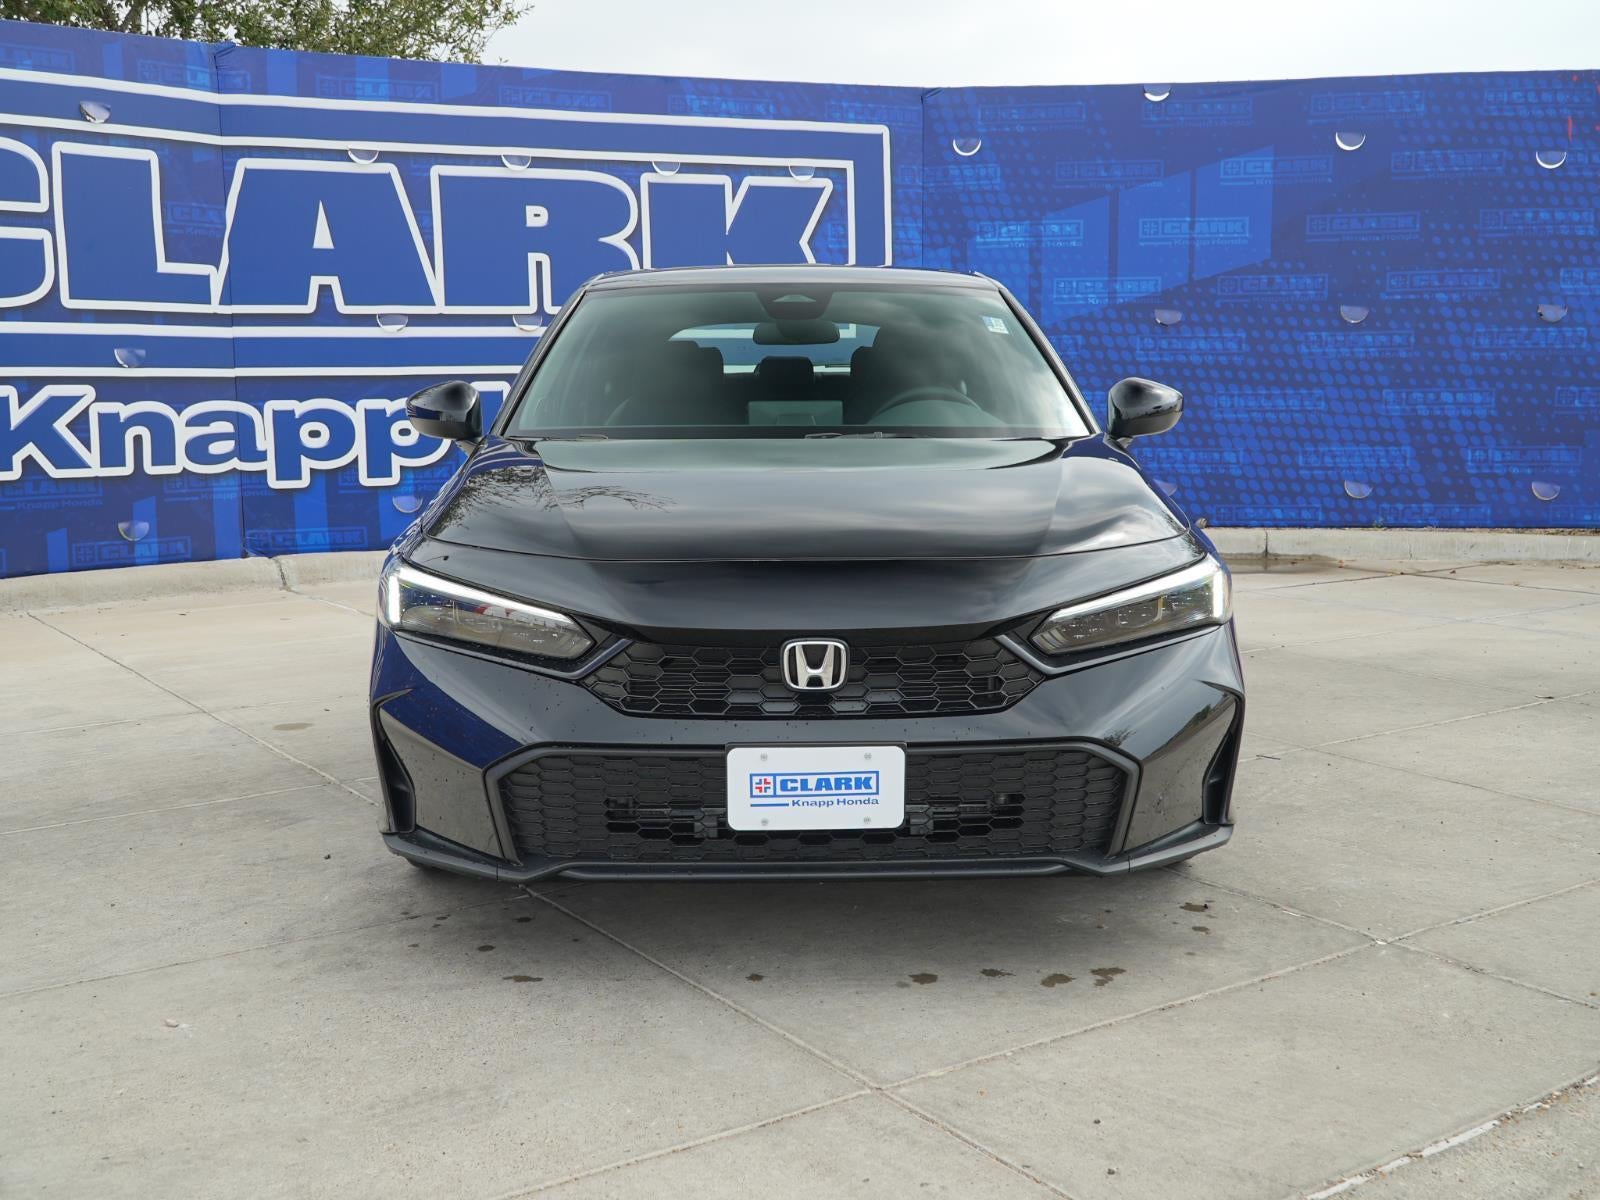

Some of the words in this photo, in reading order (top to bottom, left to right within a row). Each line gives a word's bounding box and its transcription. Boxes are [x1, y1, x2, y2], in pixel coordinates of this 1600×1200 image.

[1164, 220, 1245, 234] CLARK
[779, 776, 873, 792] CLARK
[791, 799, 834, 809] Knapp
[836, 797, 880, 806] Honda
